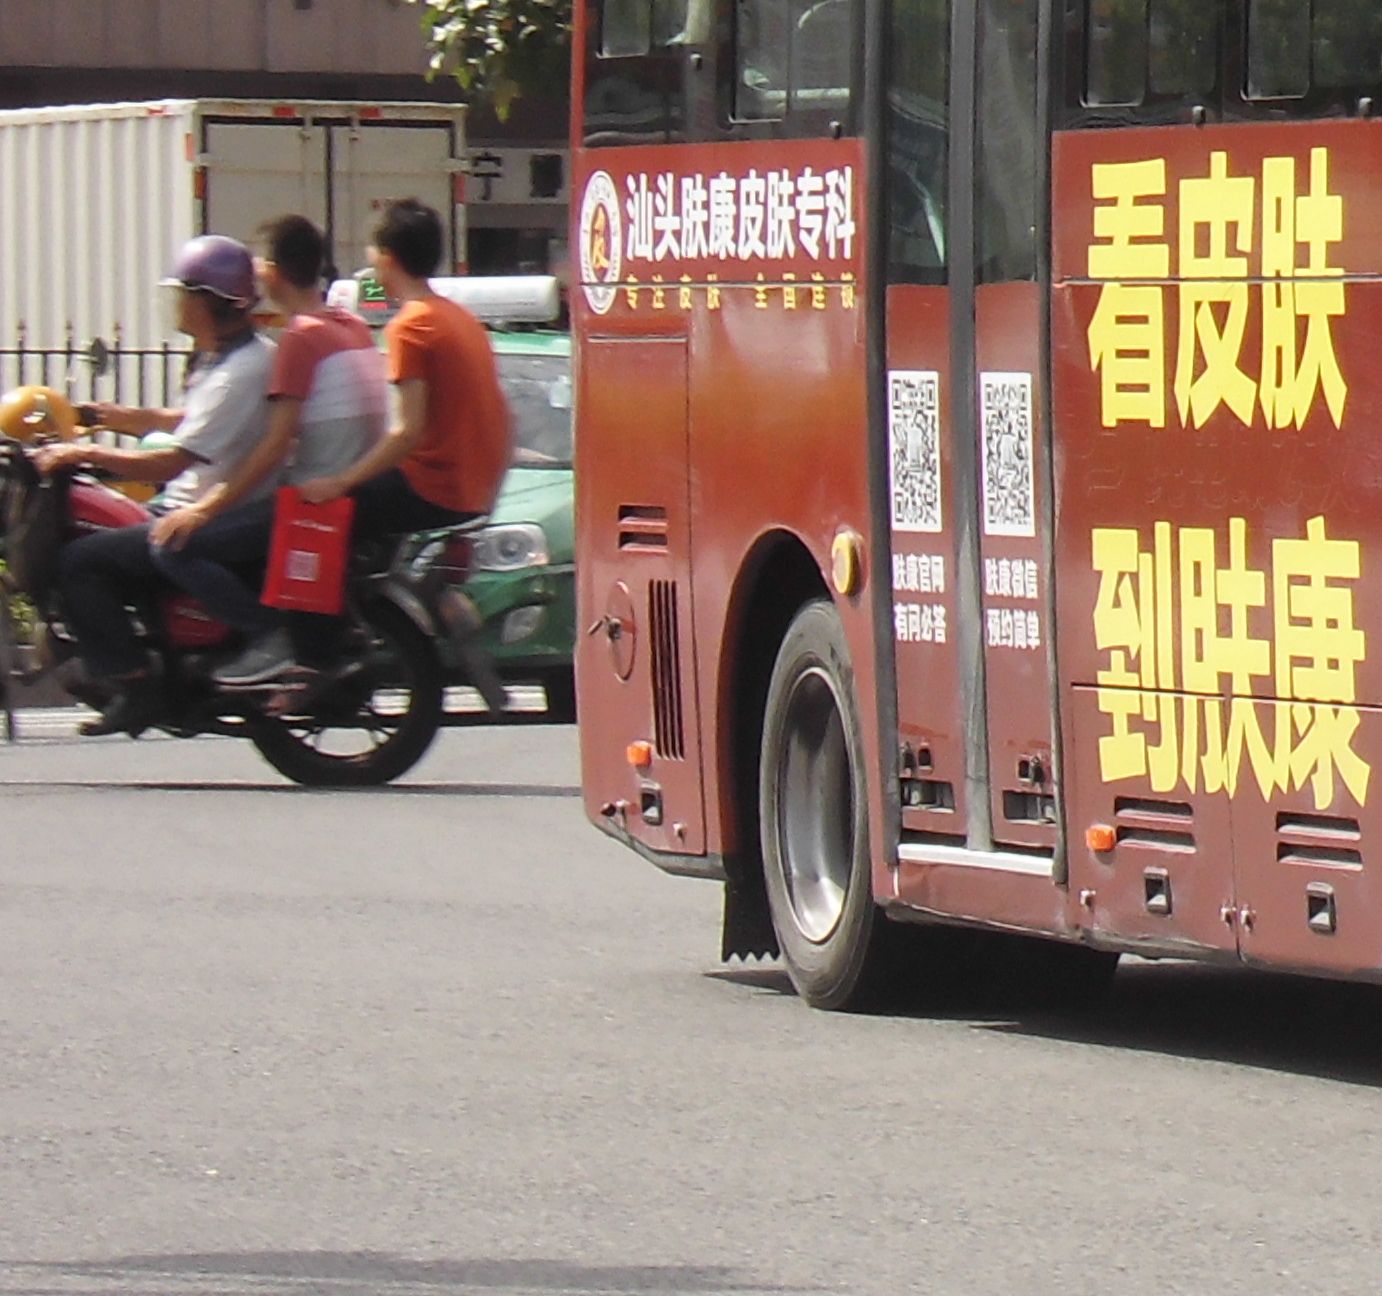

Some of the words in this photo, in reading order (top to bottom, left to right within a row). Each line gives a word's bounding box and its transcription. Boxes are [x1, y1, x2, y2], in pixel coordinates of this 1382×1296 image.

[625, 165, 857, 262] 汕头肤康皮肤专科
[1087, 146, 1348, 432] 看皮肤
[1092, 515, 1372, 810] 到肤康
